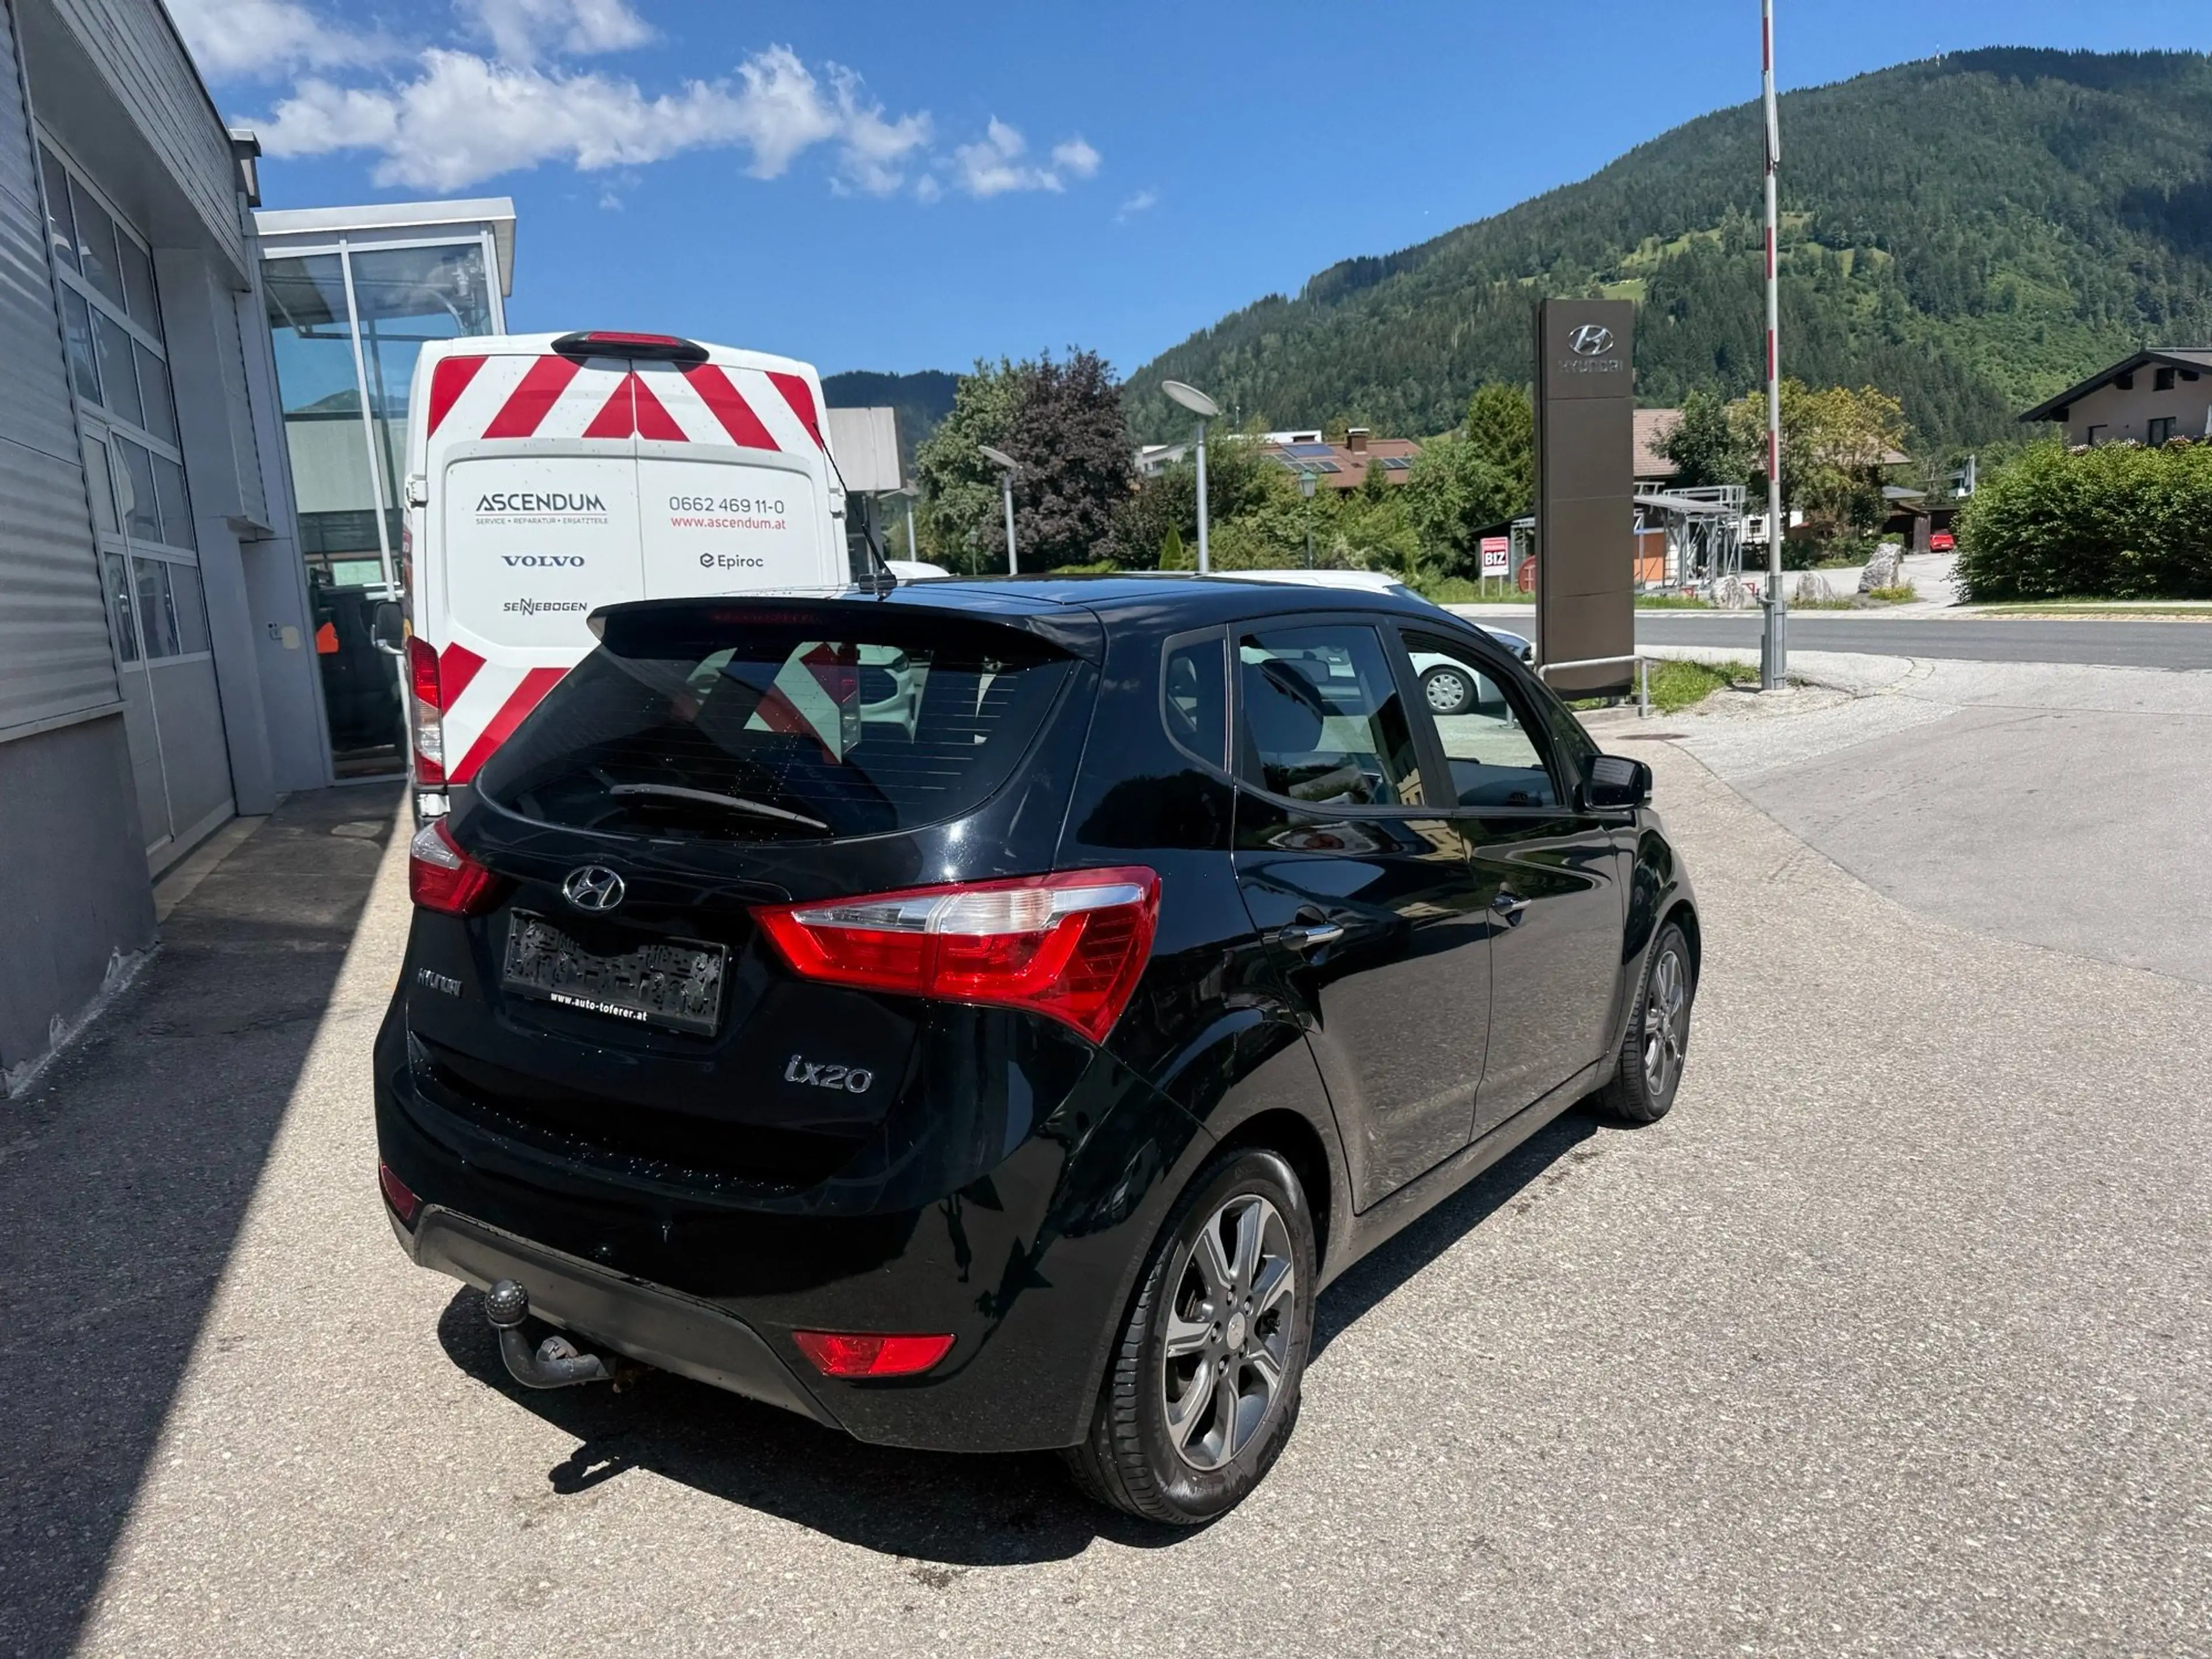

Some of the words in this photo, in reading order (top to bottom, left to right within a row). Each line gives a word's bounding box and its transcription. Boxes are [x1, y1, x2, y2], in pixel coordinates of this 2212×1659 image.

[476, 493, 607, 512] ASCENDUM
[669, 496, 714, 512] 0662
[719, 498, 751, 513] 469
[755, 499, 785, 514] 11-0
[671, 517, 786, 530] www.ascendum.at
[501, 556, 585, 567] VOLVO
[718, 555, 764, 570] Epiroc
[503, 598, 588, 616] SENNEBOGEN
[550, 993, 647, 1021] www.auto-toferer.at
[784, 1054, 873, 1093] ix20
